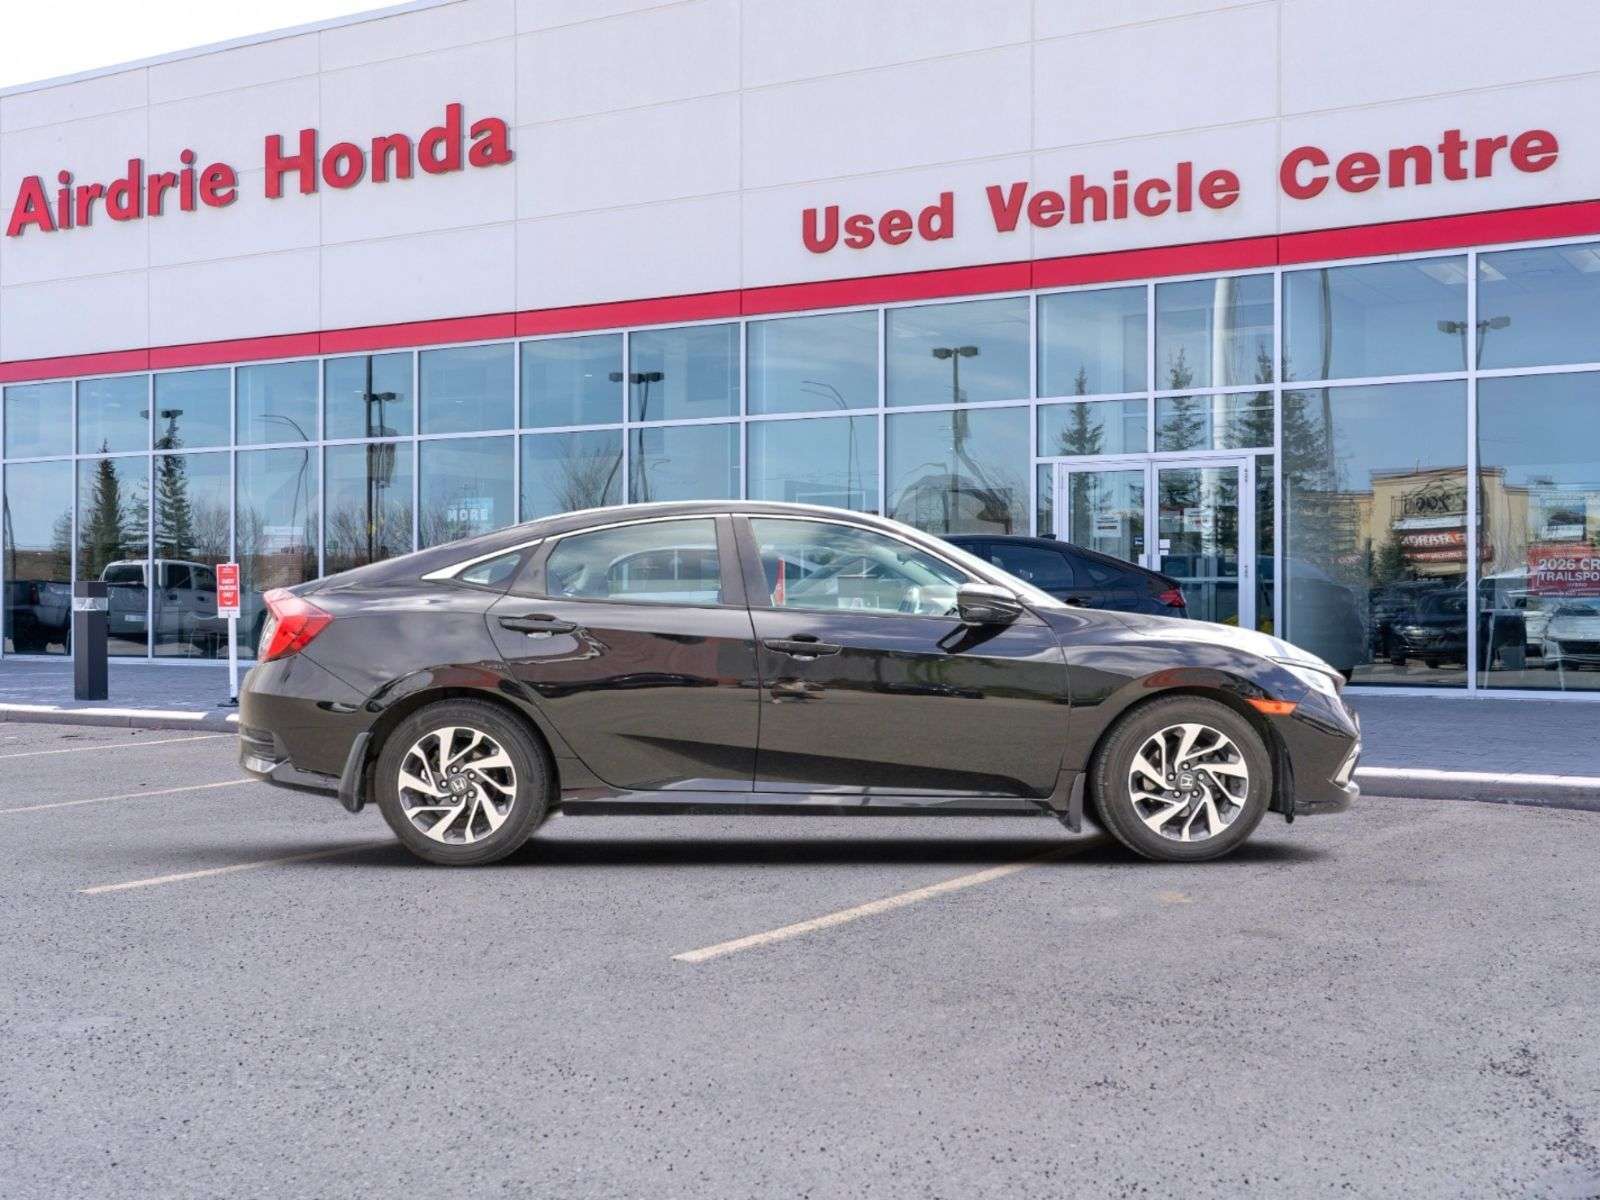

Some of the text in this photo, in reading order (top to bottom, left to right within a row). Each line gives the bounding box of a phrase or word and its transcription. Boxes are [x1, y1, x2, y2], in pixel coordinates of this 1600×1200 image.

[7, 102, 514, 237] Airdrie Honda
[802, 129, 1559, 253] Used Vehicle Centre
[1539, 558, 1576, 570] 2026
